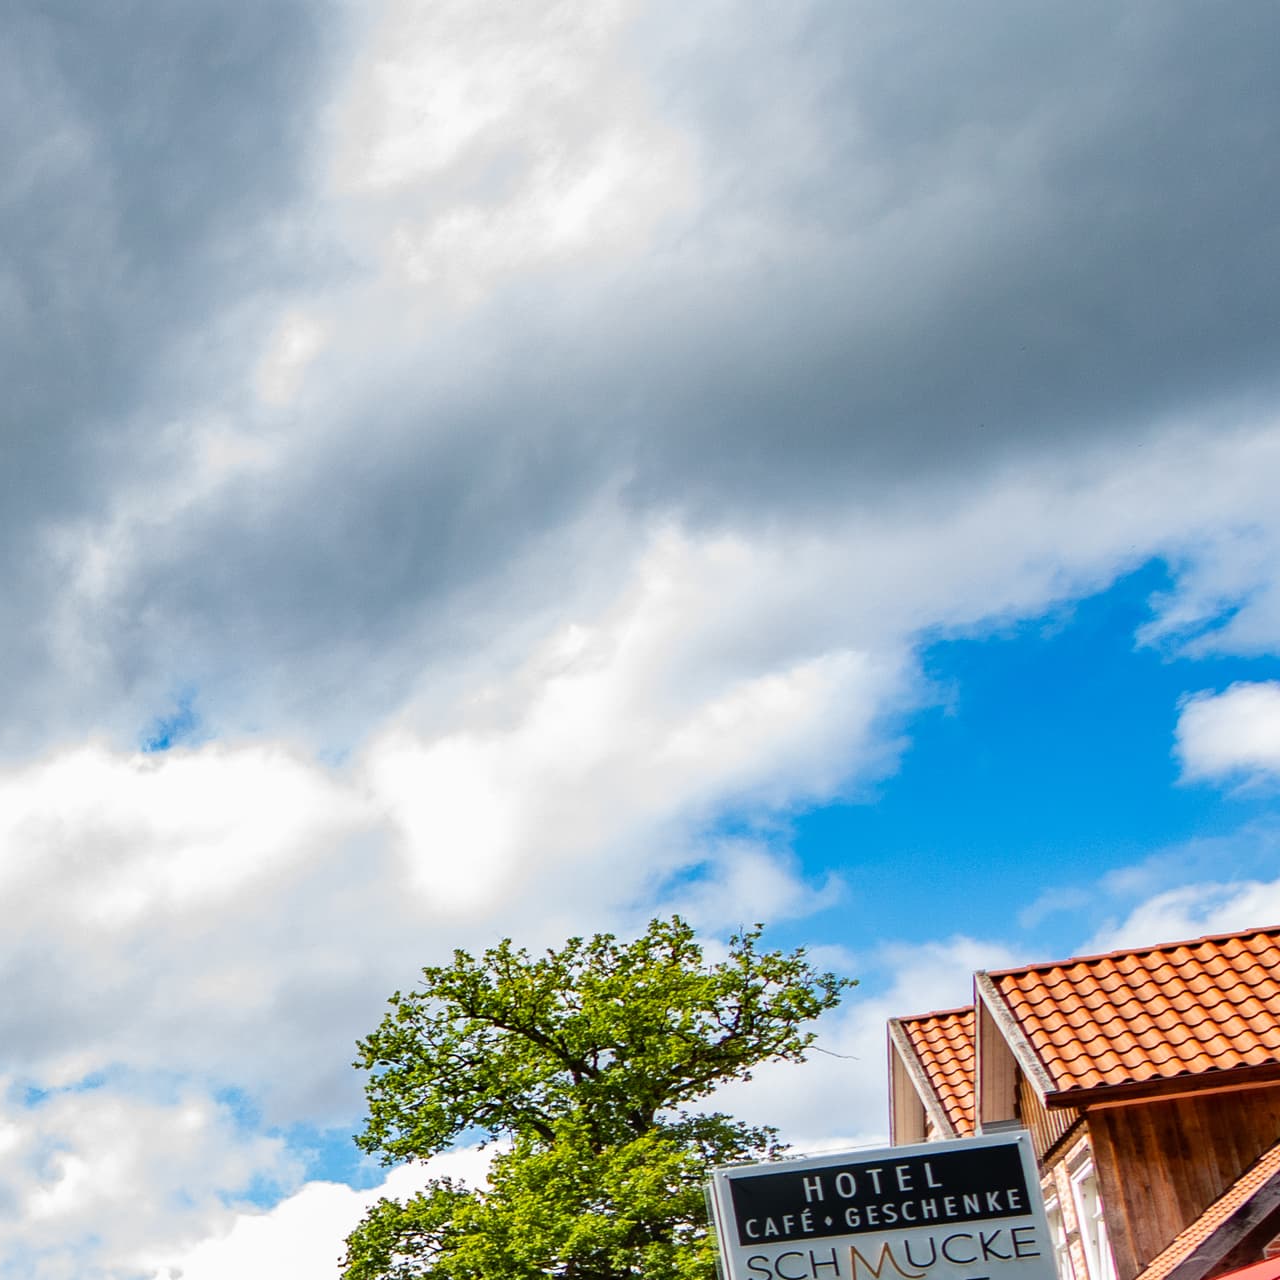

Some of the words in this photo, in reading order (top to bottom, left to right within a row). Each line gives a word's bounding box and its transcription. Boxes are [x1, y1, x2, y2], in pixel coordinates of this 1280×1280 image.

[803, 1162, 943, 1203] HOTEL
[745, 1208, 816, 1238] CAFÉ
[844, 1188, 1023, 1228] GESCHENKE
